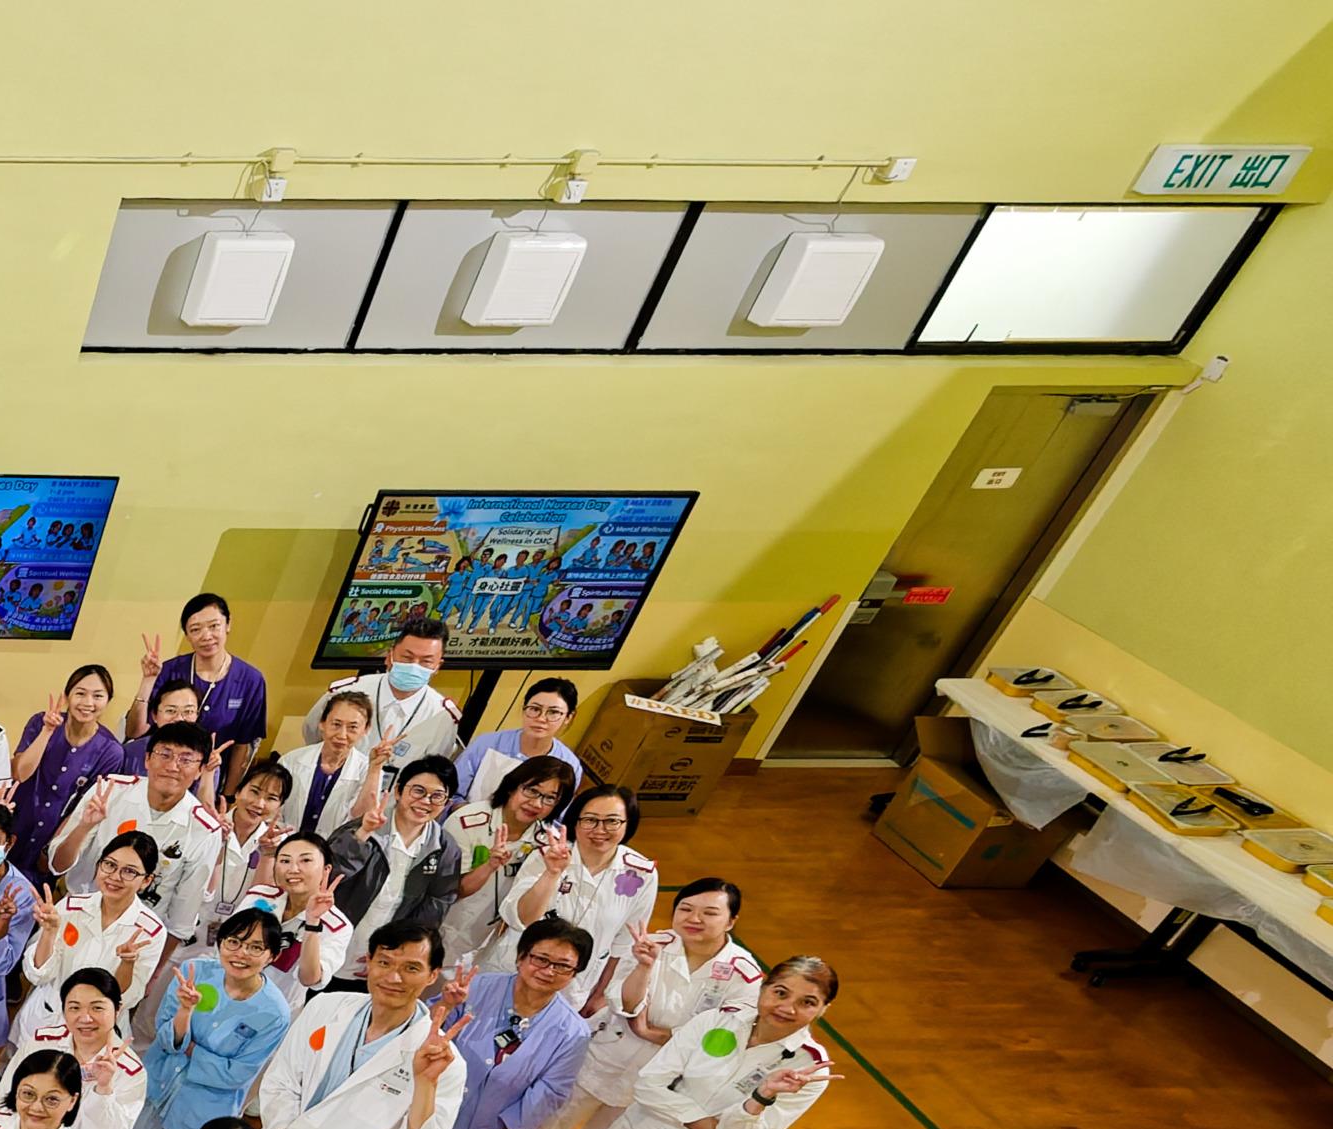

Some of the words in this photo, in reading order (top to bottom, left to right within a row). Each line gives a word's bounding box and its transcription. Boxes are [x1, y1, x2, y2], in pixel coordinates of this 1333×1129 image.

[1162, 155, 1233, 188] EXIT
[1229, 154, 1290, 188] 出口
[14, 481, 39, 493] Day
[467, 499, 543, 510] International
[543, 500, 584, 510] Nurses
[585, 500, 611, 512] Day
[499, 511, 567, 522] Celebration
[497, 528, 534, 537] Solidarity
[489, 537, 523, 545] Wellness
[533, 537, 554, 545] CMC
[29, 569, 58, 578] Spiritual
[59, 569, 89, 577] Wellness
